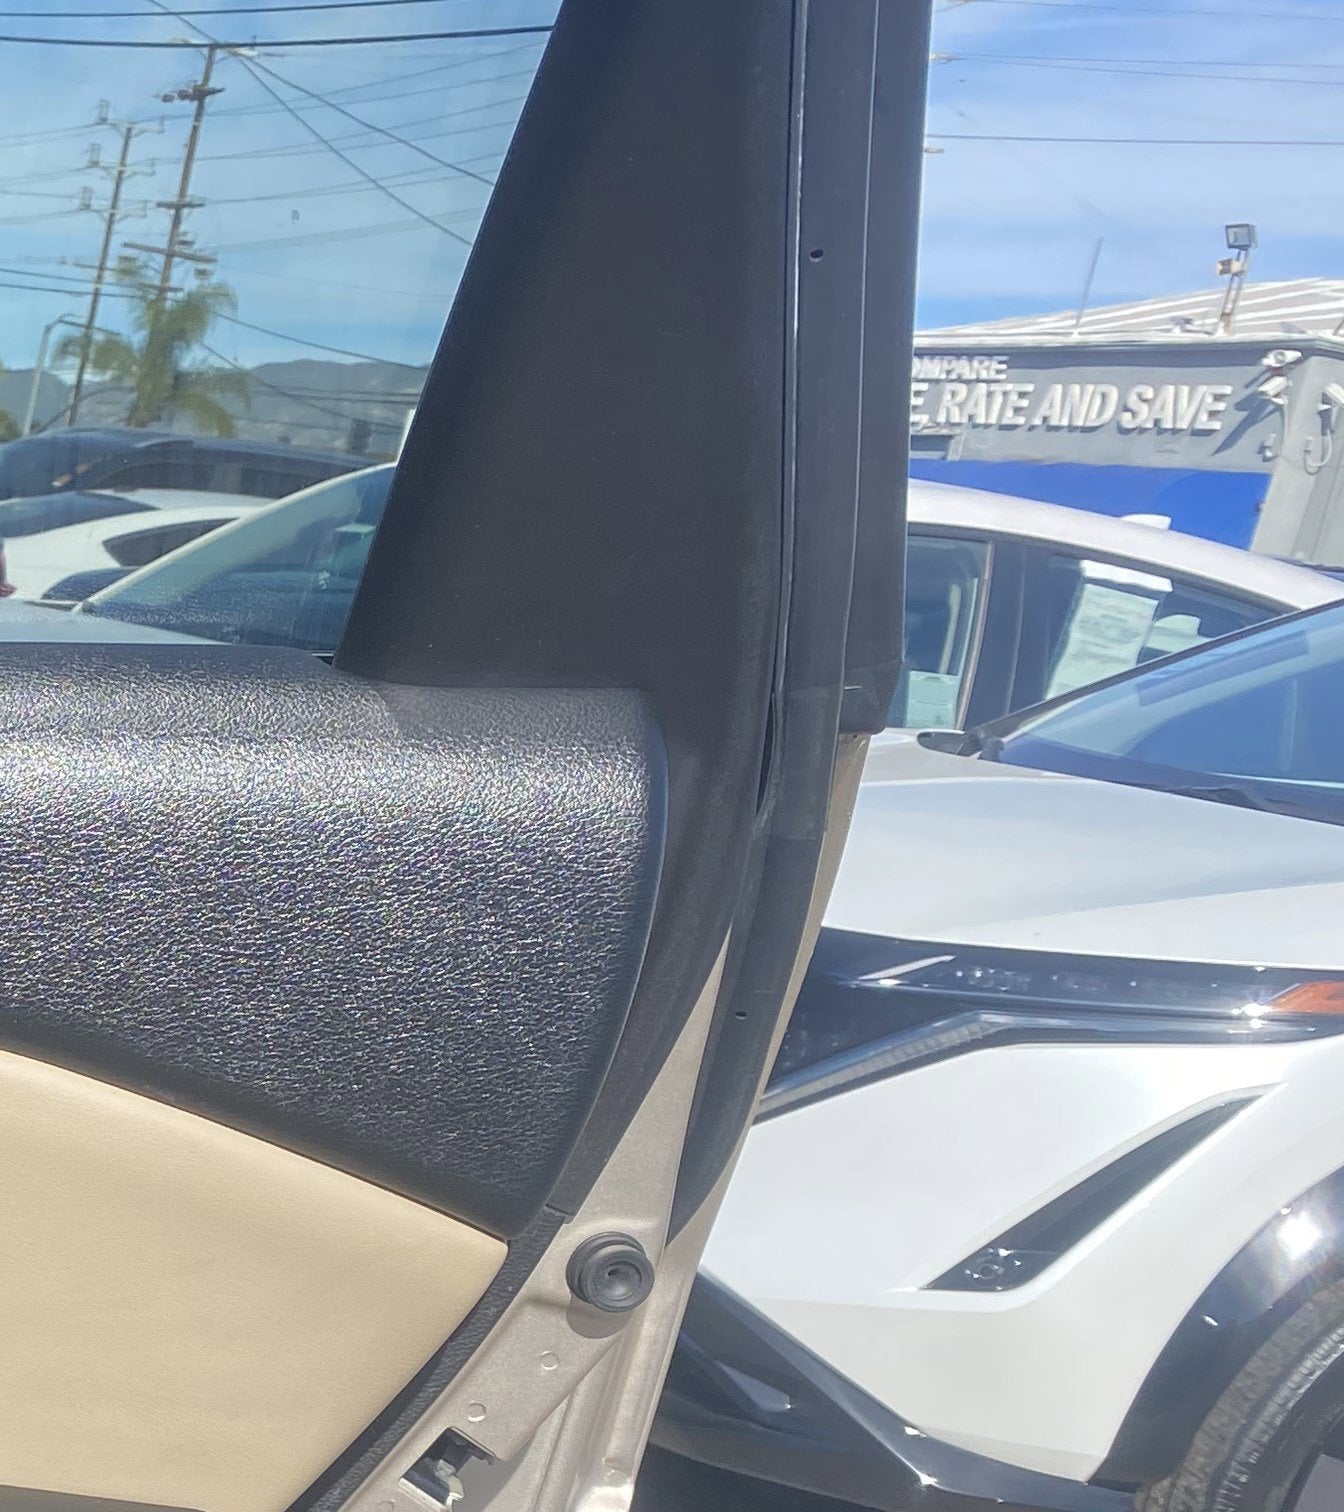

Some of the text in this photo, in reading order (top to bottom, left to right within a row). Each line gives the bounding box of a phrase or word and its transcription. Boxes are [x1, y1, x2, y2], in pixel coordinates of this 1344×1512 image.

[936, 382, 1035, 424] RATE
[1032, 383, 1119, 427] AND
[1120, 384, 1233, 430] SAVE
